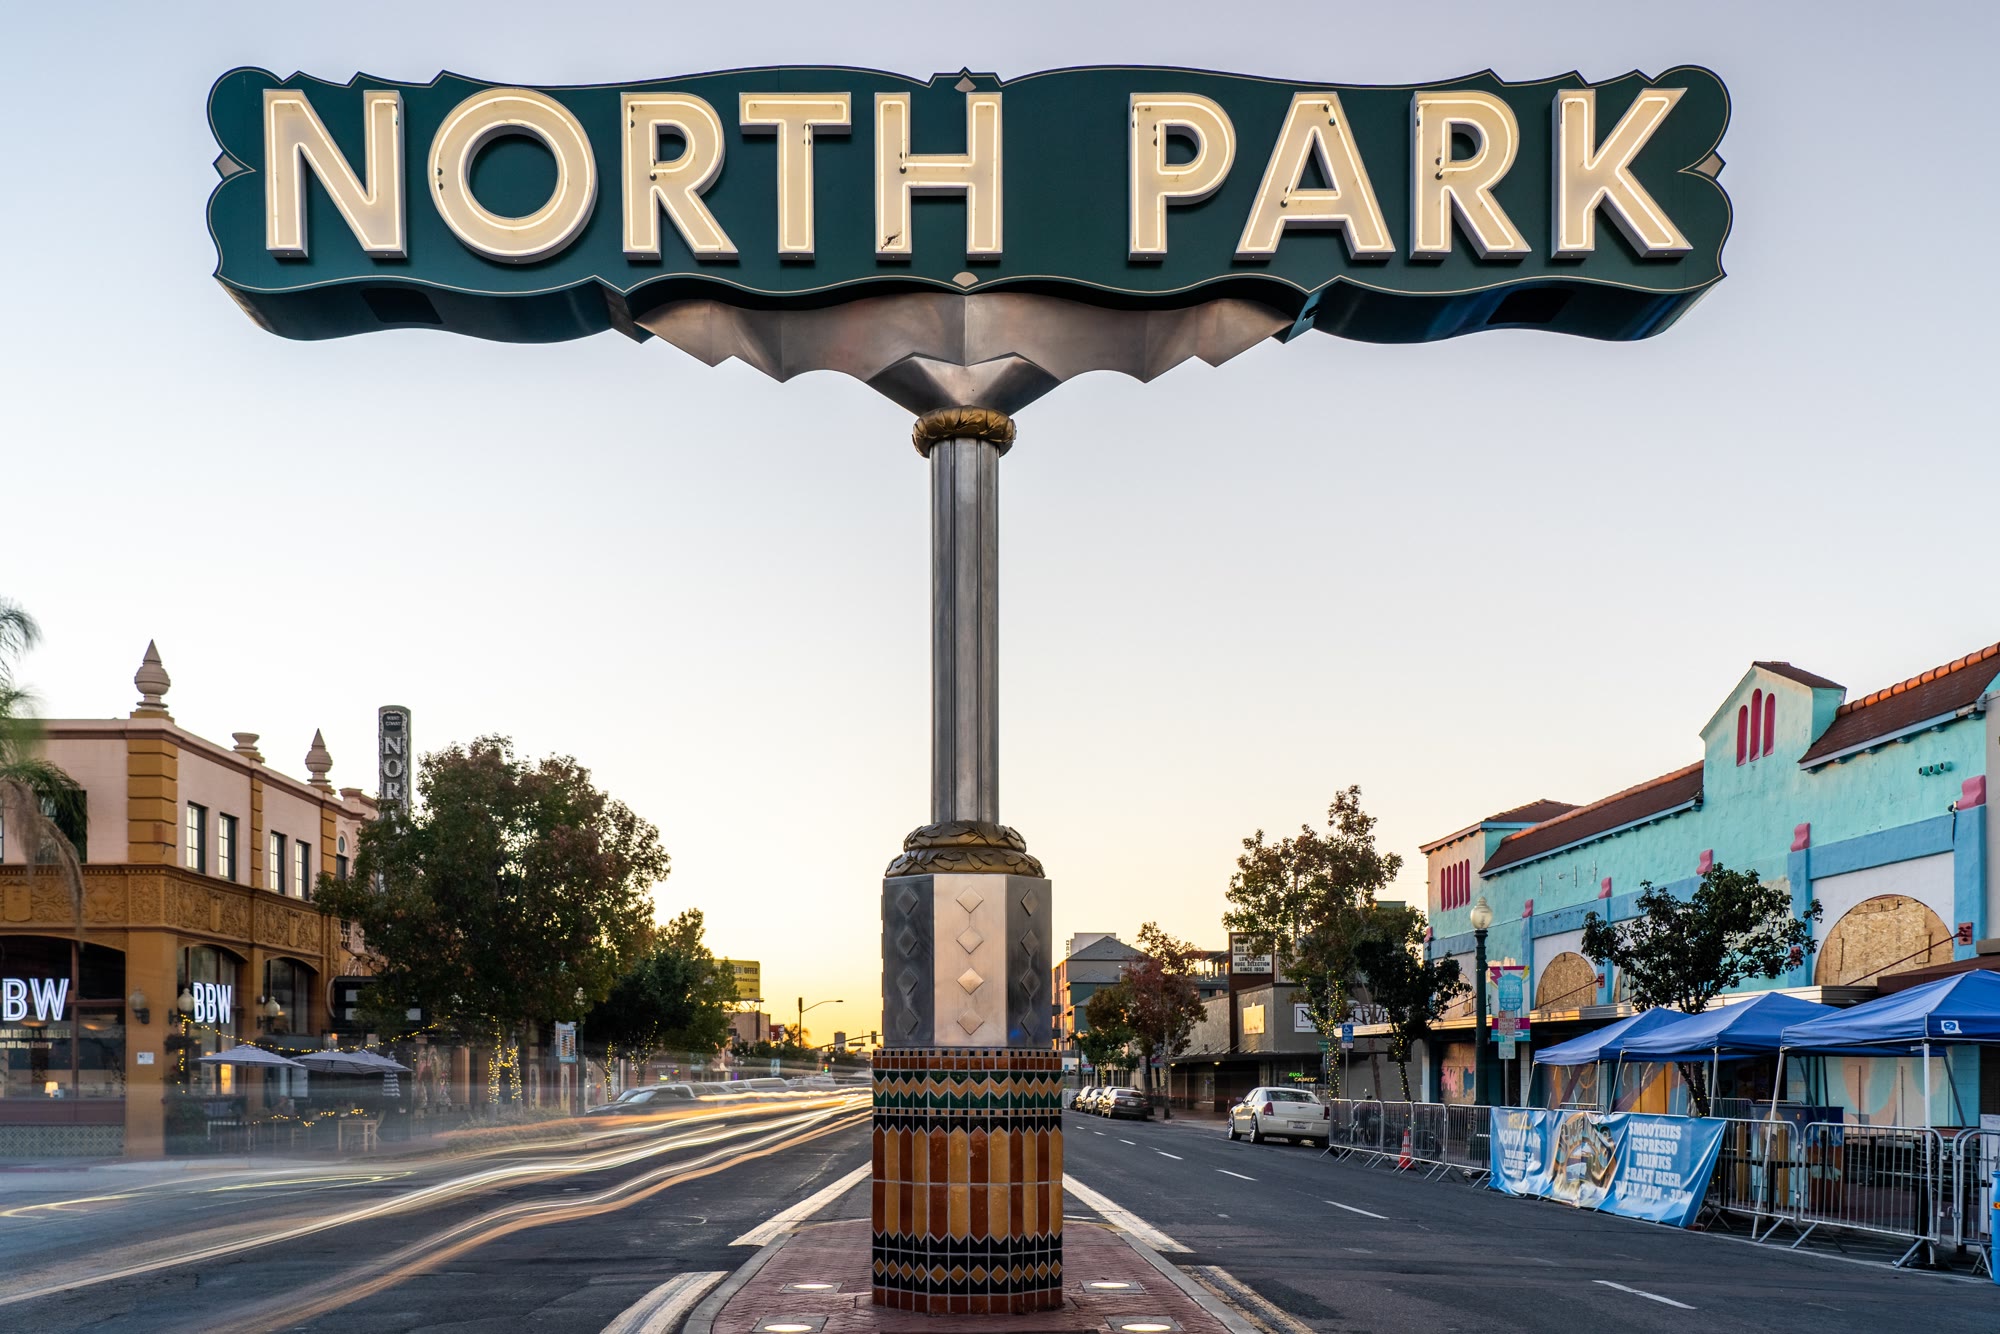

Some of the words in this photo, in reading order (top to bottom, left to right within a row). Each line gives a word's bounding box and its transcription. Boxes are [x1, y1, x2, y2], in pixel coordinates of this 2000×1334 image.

[263, 87, 1004, 264] NORTH
[1128, 86, 1694, 262] PARK
[193, 982, 232, 1024] BBW
[1628, 1122, 1682, 1140] SMOOTHIES
[1631, 1138, 1678, 1156] ESPRESSO
[1635, 1153, 1672, 1171] DRINKS
[1624, 1167, 1655, 1184] CRAFT
[1655, 1170, 1681, 1189] BEER
